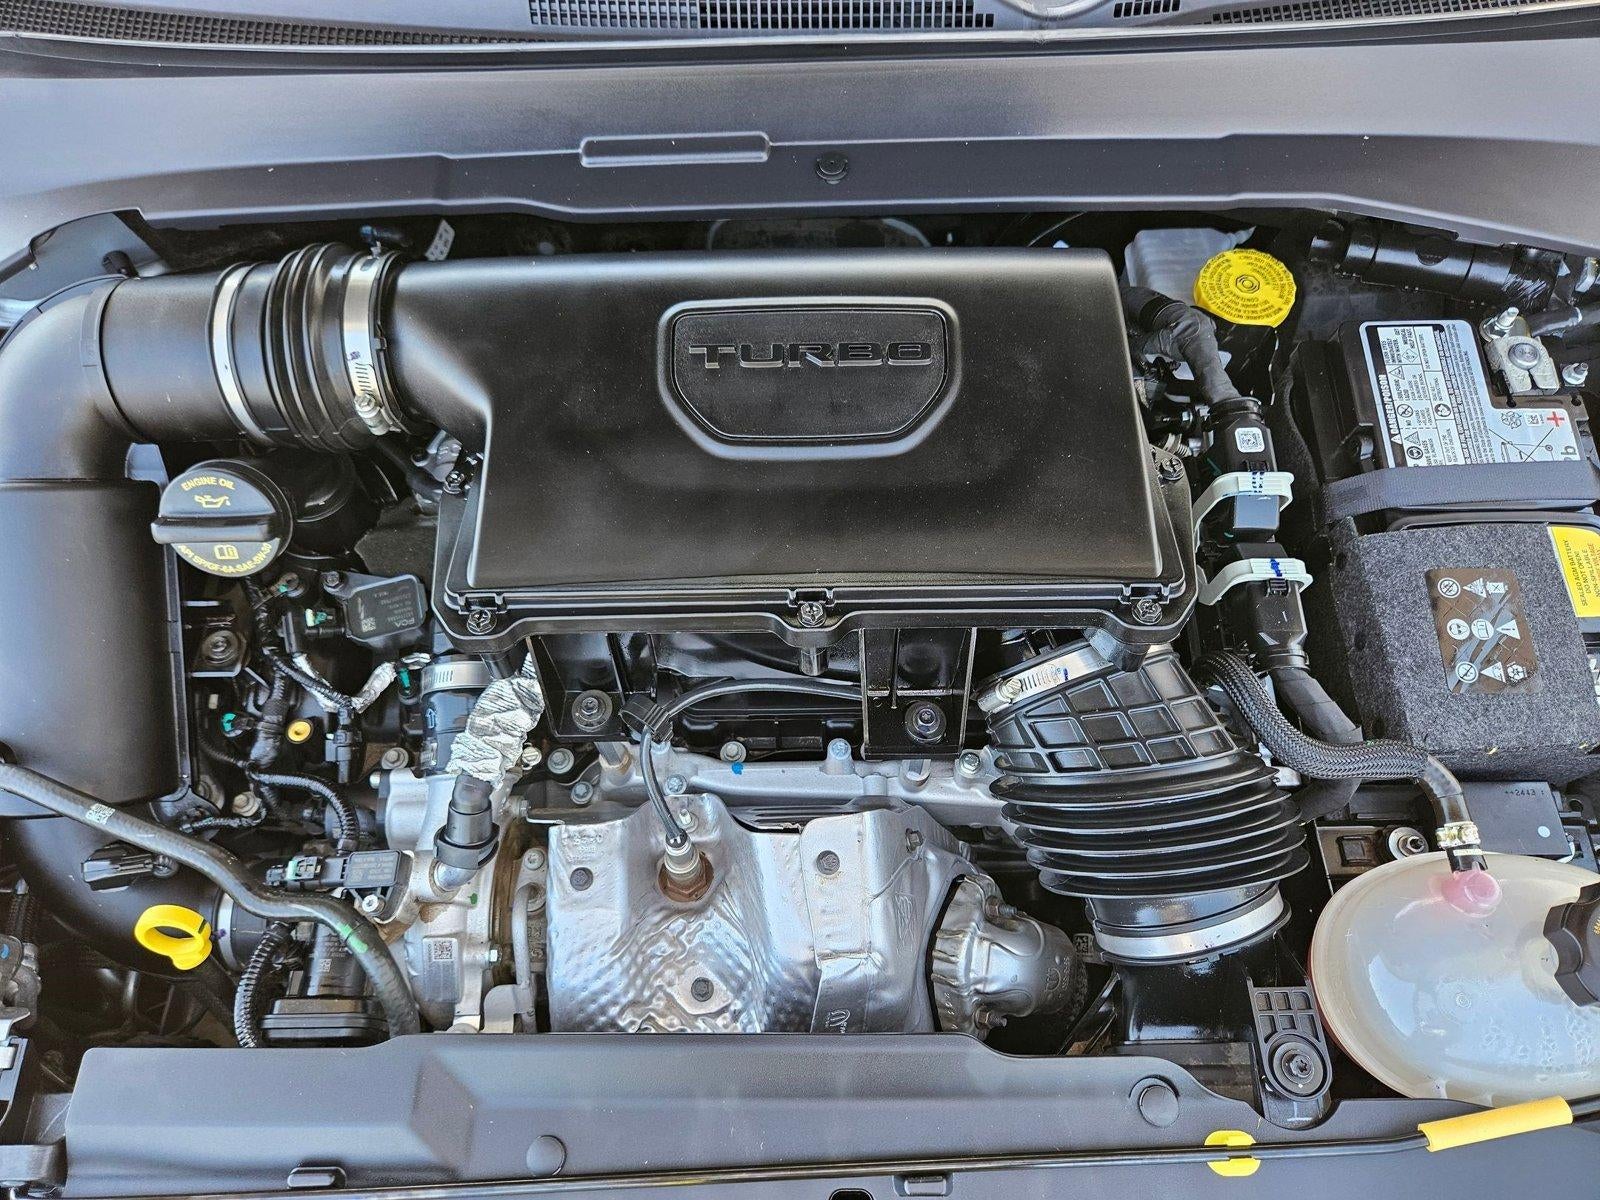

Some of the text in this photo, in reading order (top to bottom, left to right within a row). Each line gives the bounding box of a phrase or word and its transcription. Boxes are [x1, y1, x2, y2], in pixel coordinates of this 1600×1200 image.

[688, 342, 934, 368] TURBO
[1379, 374, 1399, 435] DANGER/POISON
[181, 476, 236, 491] ENGINE OIL
[178, 545, 194, 559] API
[1563, 539, 1588, 606] SEALED AGM BATTERY
[1580, 568, 1589, 583] NOT
[394, 618, 415, 628] FCA
